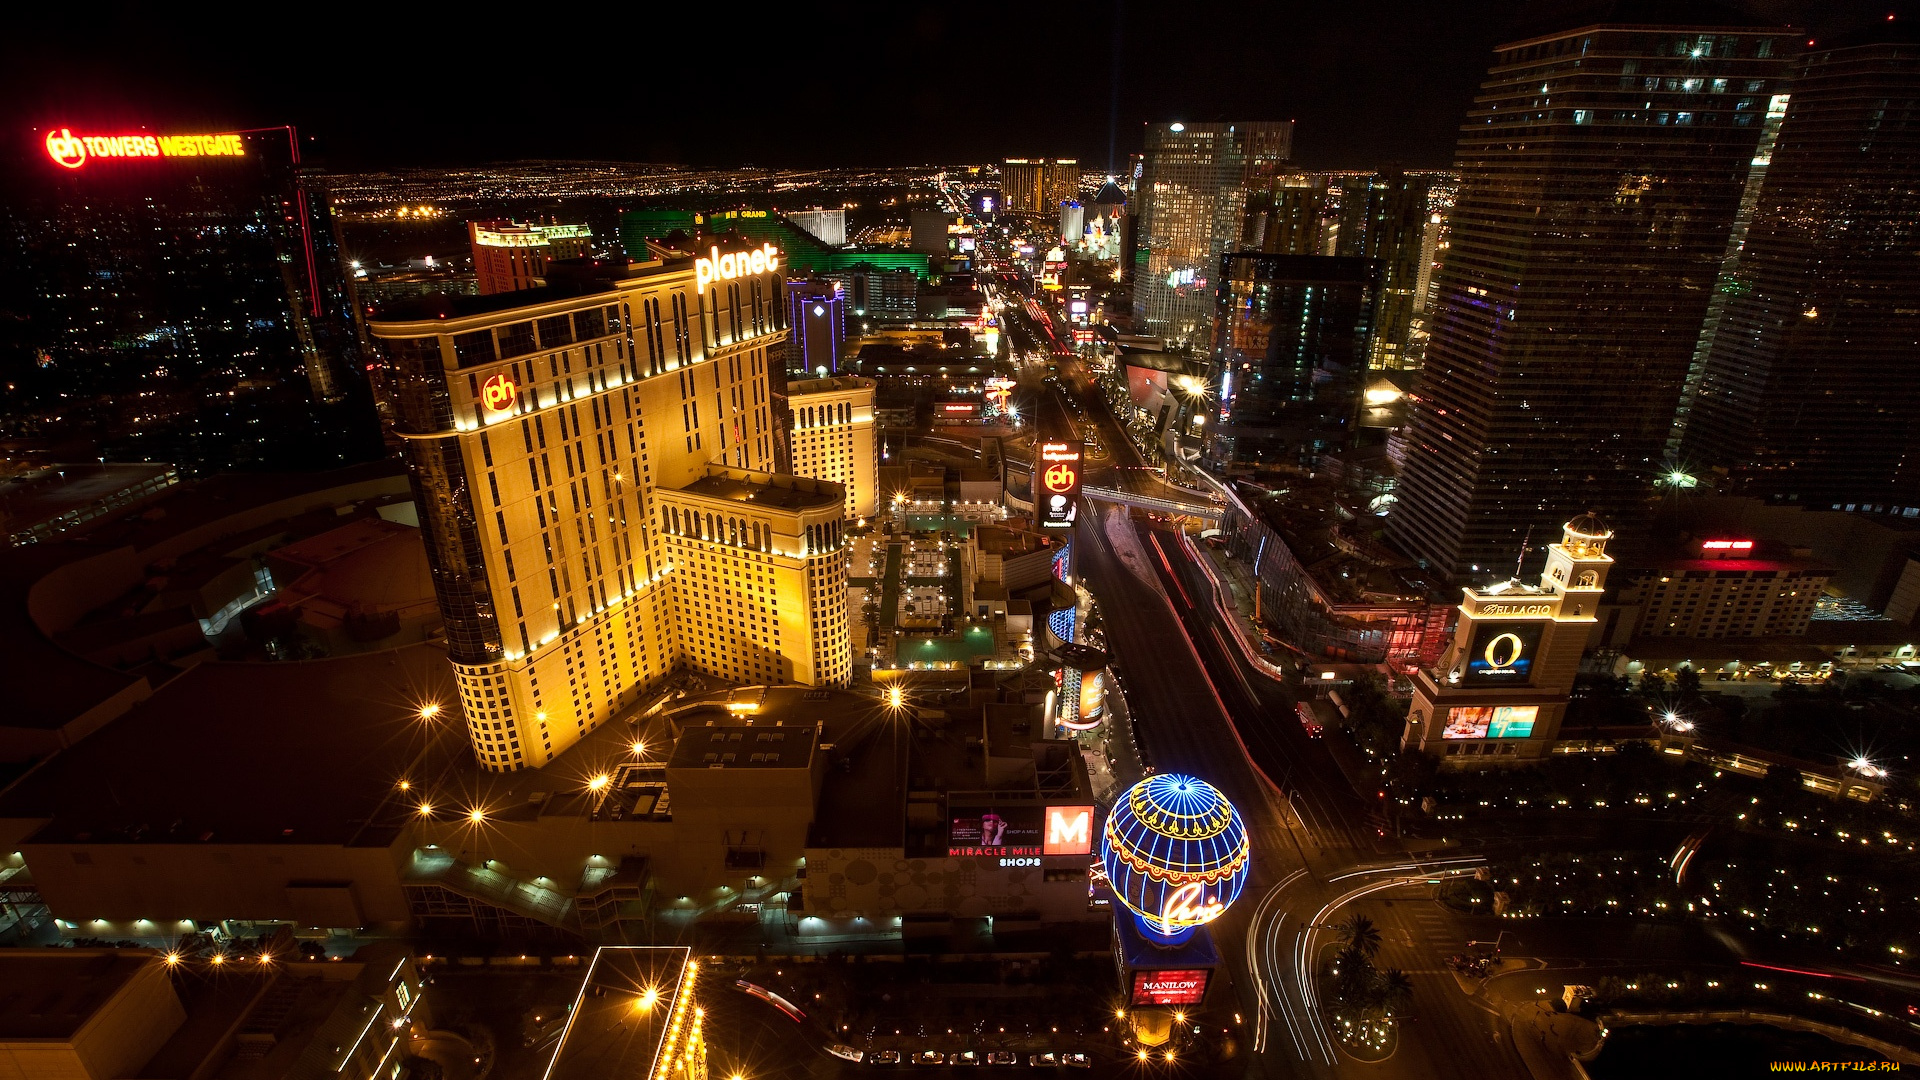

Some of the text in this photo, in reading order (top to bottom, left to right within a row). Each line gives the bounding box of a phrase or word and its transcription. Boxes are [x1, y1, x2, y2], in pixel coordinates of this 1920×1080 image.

[82, 136, 159, 157] TOWERS
[157, 135, 244, 156] WESTGATE
[695, 243, 779, 294] planet
[484, 374, 516, 412] ph
[1045, 464, 1075, 492] ph
[1478, 604, 1551, 615] BELLAGIO
[1485, 633, 1523, 668] O
[1049, 811, 1089, 844] M
[949, 847, 1041, 856] MIRACLE MILE
[999, 858, 1041, 867] SHOPS
[1162, 882, 1224, 935] Paris
[1143, 981, 1198, 990] MANILOW
